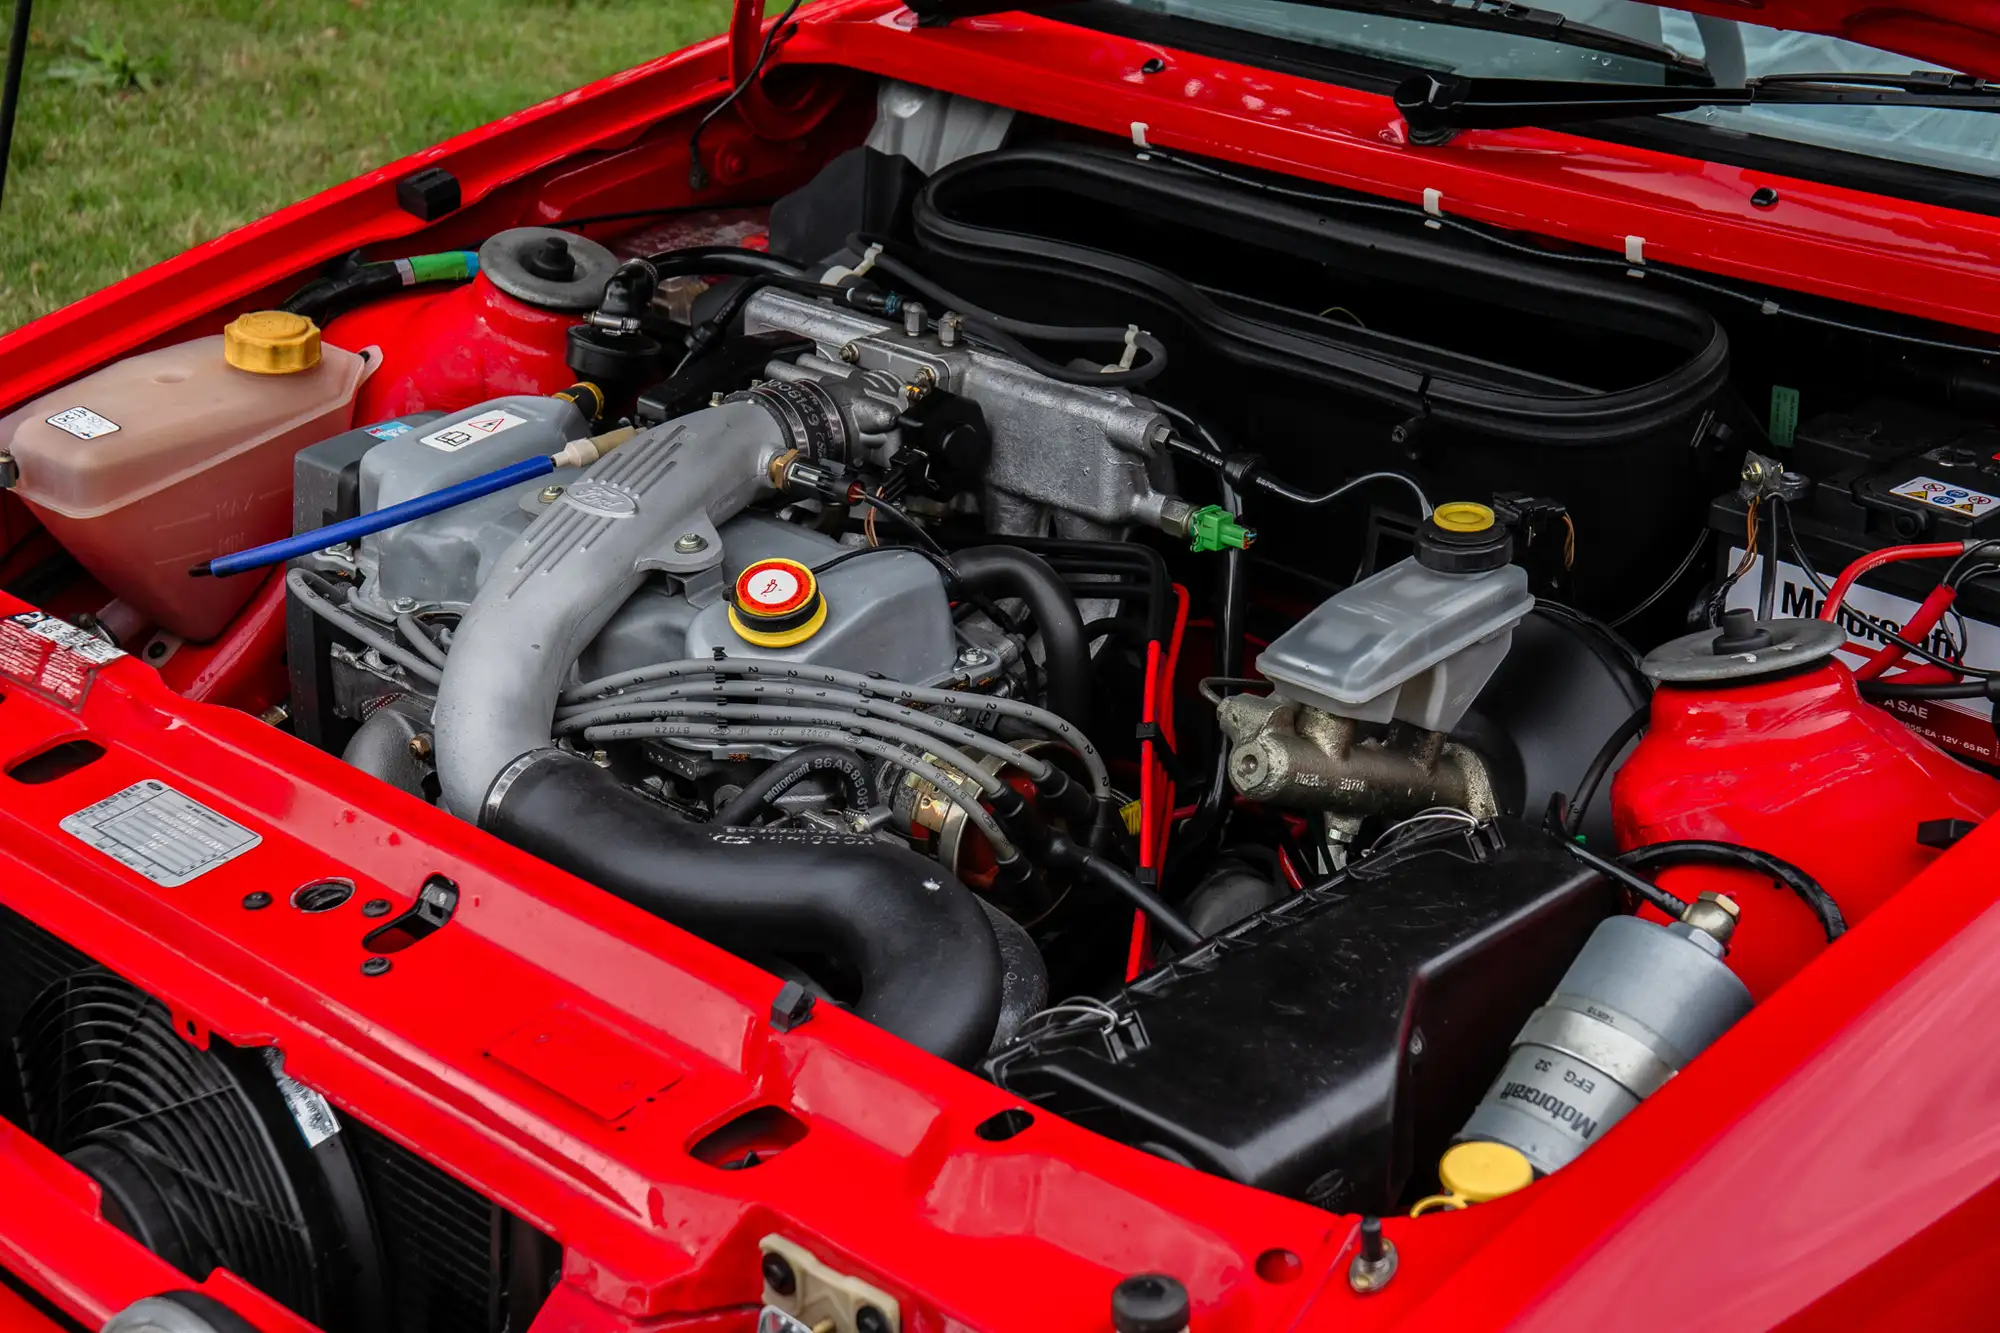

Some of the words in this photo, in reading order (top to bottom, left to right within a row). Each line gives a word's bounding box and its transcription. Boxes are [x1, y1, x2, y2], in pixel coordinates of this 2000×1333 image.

[1782, 581, 1955, 660] Mtorcft
[1897, 700, 1928, 719] SAE
[654, 727, 690, 735] B7028
[1942, 735, 1958, 745] 12V
[1963, 741, 1976, 751] 65
[1976, 745, 1990, 756] RC
[762, 762, 811, 803] Motorcraft
[1534, 1058, 1552, 1072] 32
[1563, 1069, 1595, 1094] EFG
[1501, 1082, 1598, 1140] Motorcraft
